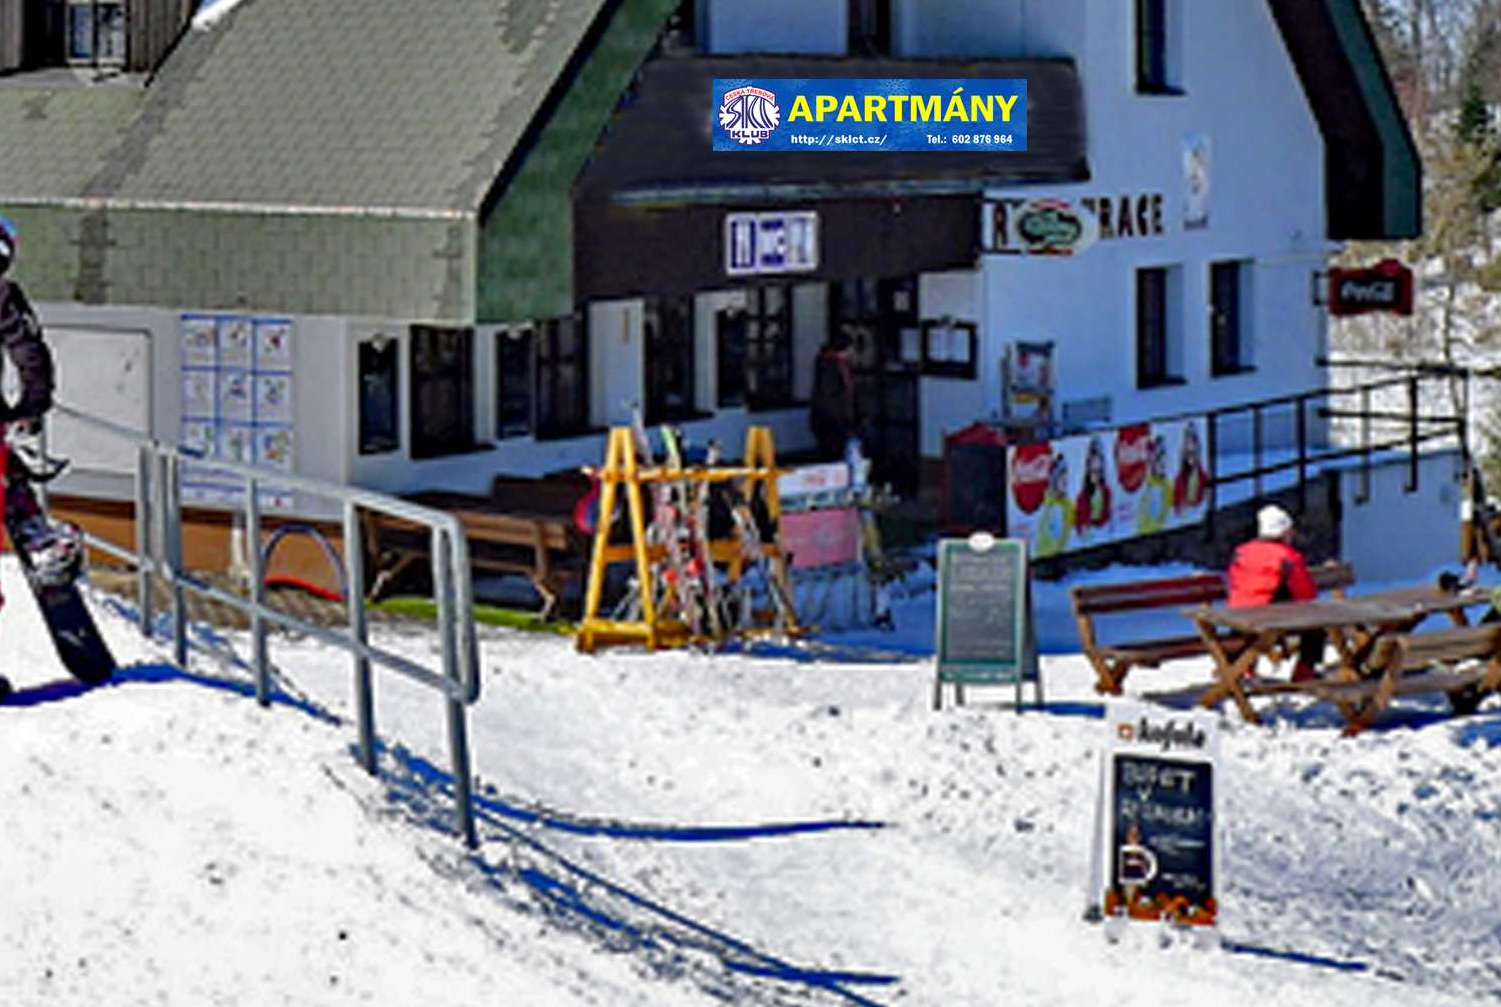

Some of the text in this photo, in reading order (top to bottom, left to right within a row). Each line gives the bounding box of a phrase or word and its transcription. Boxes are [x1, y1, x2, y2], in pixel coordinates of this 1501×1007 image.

[787, 86, 1019, 122] APARTMÁNY
[731, 130, 769, 139] KLUB
[926, 134, 1013, 144] Tel.: 602 876 964
